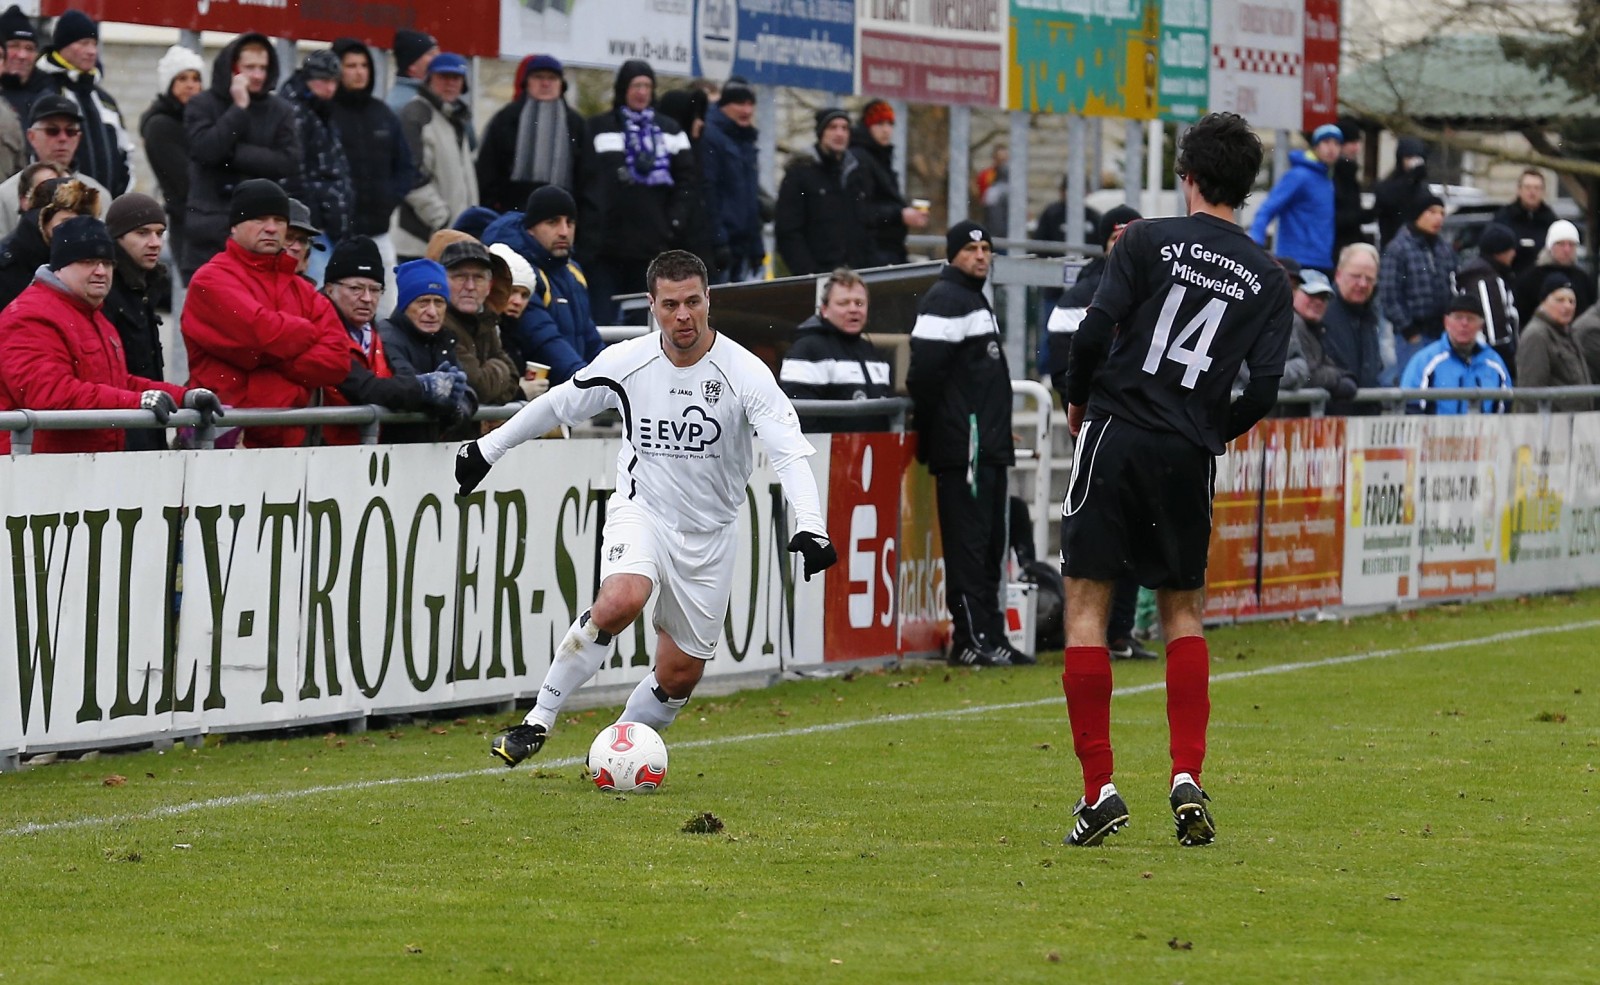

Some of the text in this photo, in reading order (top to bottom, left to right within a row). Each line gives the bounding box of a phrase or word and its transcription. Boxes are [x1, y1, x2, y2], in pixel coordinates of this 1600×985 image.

[1160, 242, 1262, 294] SV Germania
[1171, 261, 1244, 300] Mittweida
[1142, 283, 1228, 389] 14
[658, 420, 703, 442] EVP
[641, 449, 689, 459] Energieversorgung
[542, 683, 561, 697] JAKO
